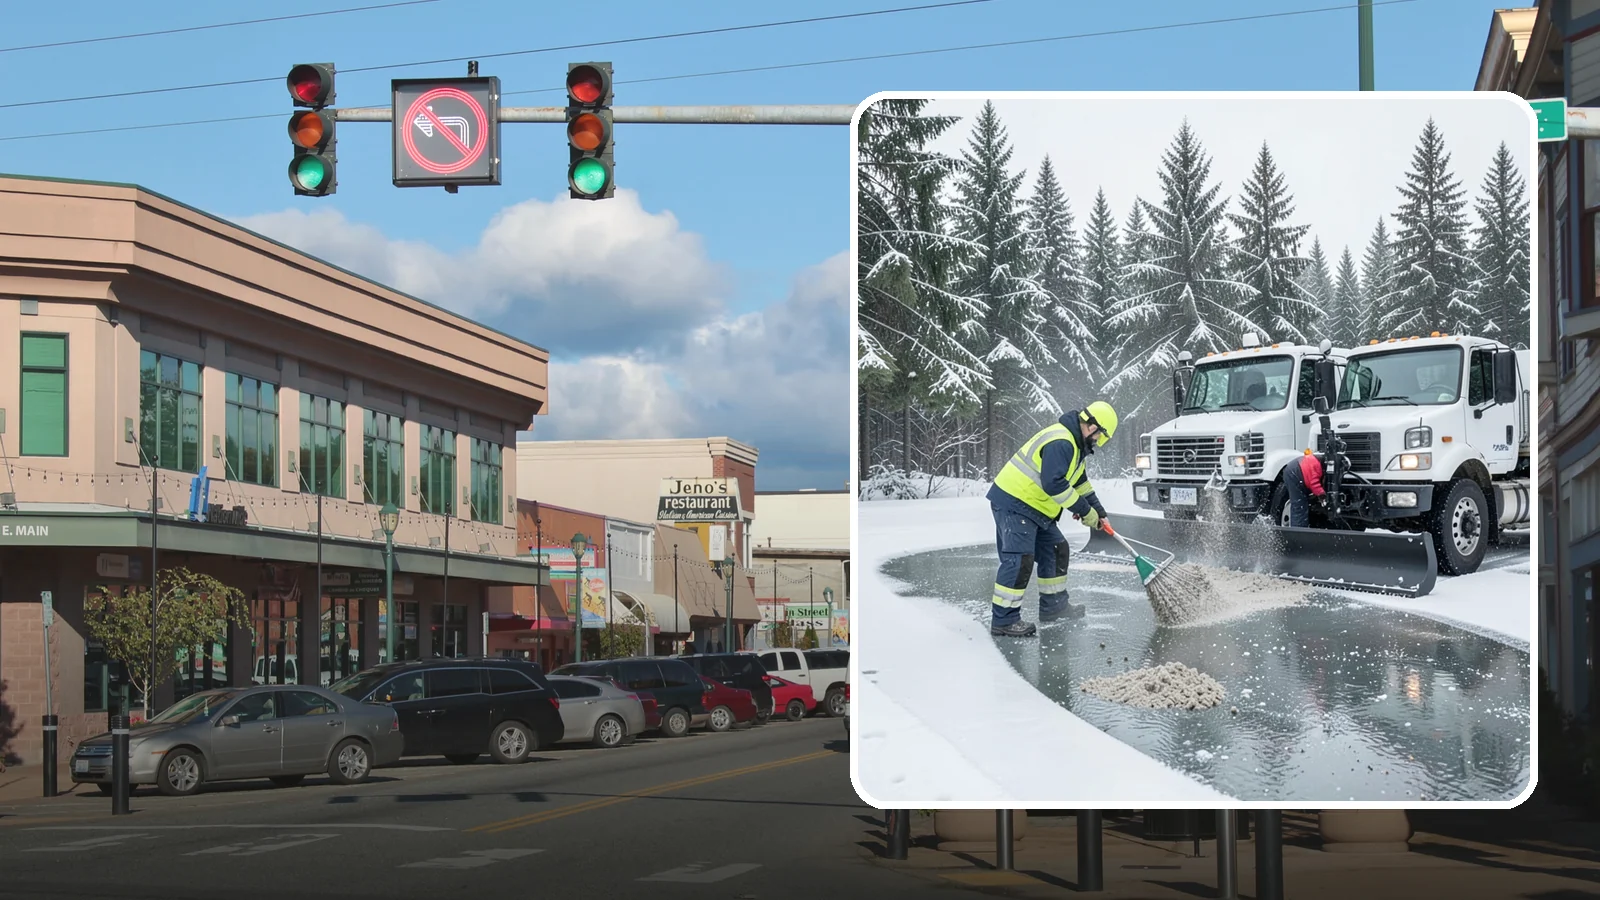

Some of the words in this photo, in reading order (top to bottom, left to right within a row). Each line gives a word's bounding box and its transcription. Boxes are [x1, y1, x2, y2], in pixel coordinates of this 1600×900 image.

[670, 480, 727, 494] Jeno's
[665, 496, 731, 509] restaurant
[658, 509, 682, 520] Italian
[686, 509, 714, 519] American
[715, 509, 738, 519] Cuisine
[2, 525, 13, 536] E.
[15, 525, 49, 536] MAIN
[797, 607, 828, 617] Street
